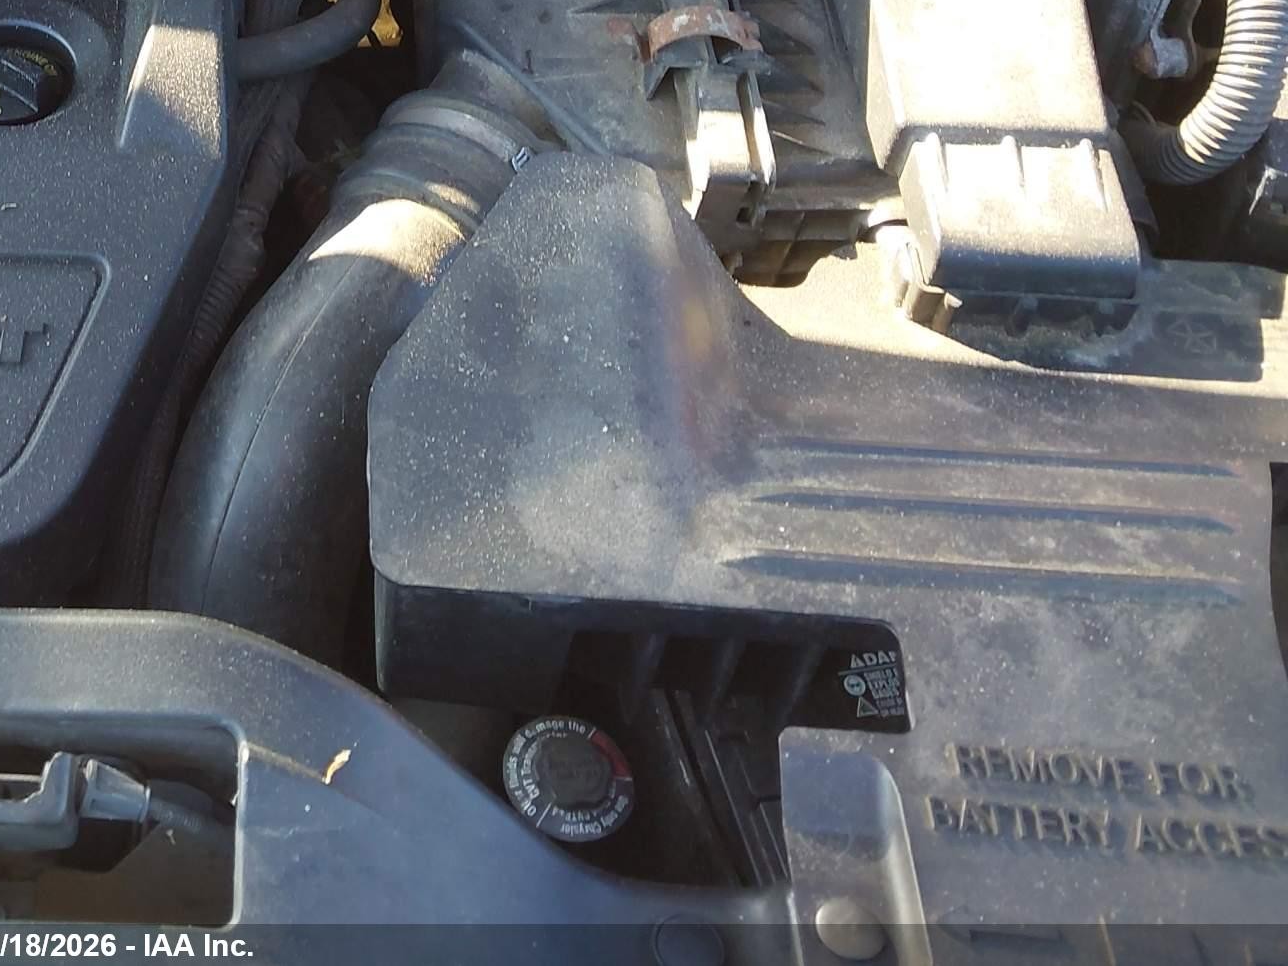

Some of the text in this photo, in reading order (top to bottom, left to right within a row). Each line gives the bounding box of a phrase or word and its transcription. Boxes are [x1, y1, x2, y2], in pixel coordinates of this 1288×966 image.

[943, 741, 1248, 802] REMOVE FOR
[923, 795, 1288, 858] BATTERY ACCES
